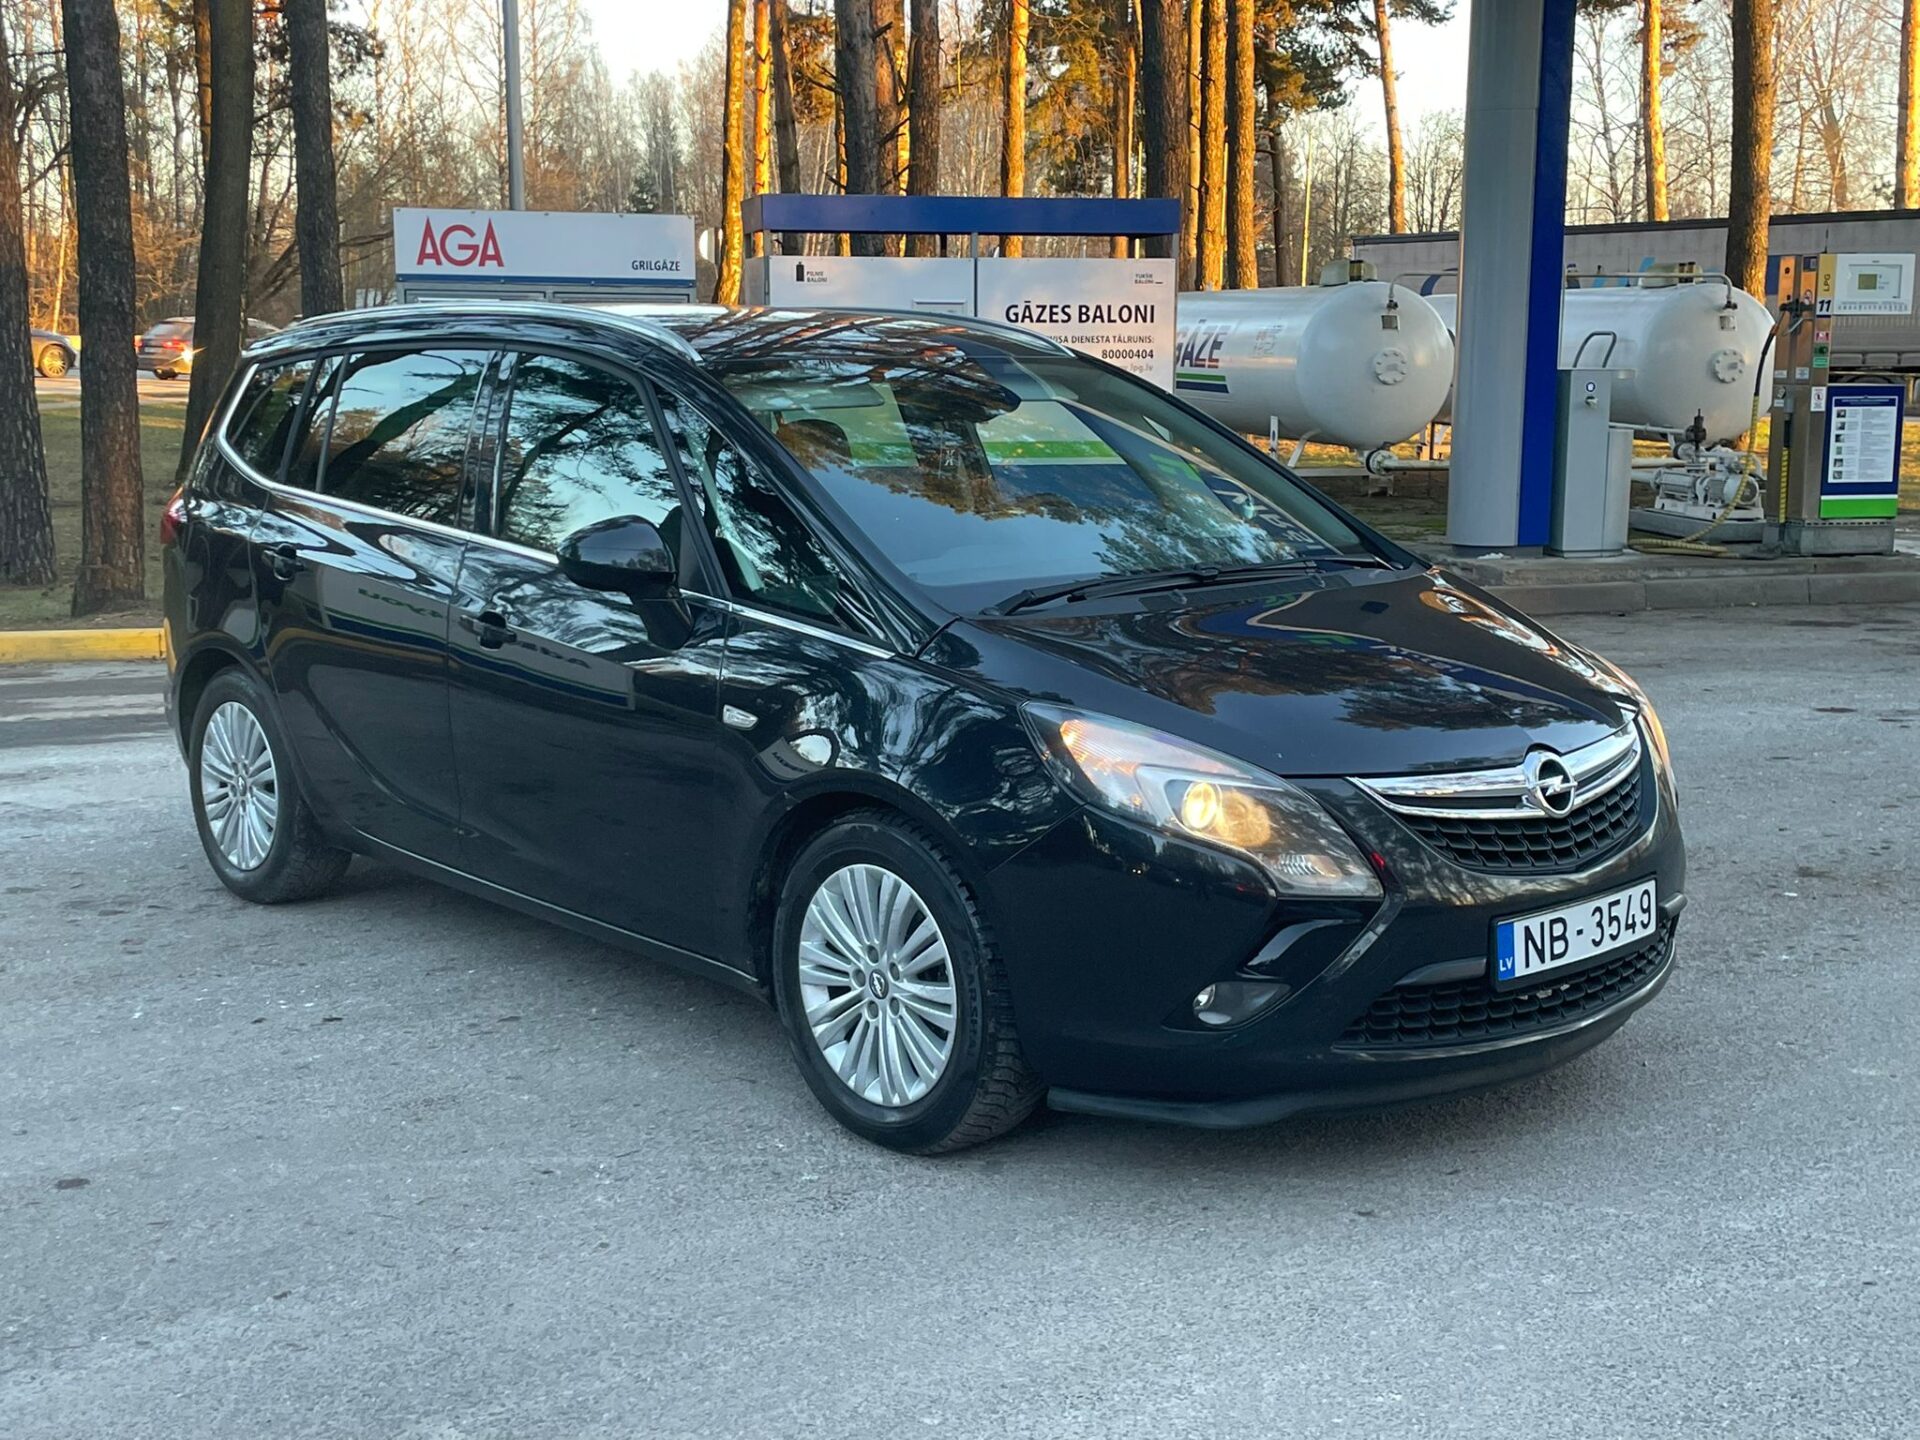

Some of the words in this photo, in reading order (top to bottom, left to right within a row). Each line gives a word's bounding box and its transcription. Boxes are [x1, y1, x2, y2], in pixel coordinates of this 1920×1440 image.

[416, 216, 505, 268] AGA
[631, 259, 681, 272] GRILGĀZE
[1823, 273, 1831, 292] LPG
[1005, 300, 1072, 324] GĀZES
[1078, 304, 1155, 324] BALONI
[1818, 300, 1832, 313] 11
[1071, 335, 1111, 344] DIENESTA
[1101, 349, 1154, 360] 80000404
[1500, 956, 1514, 972] LV
